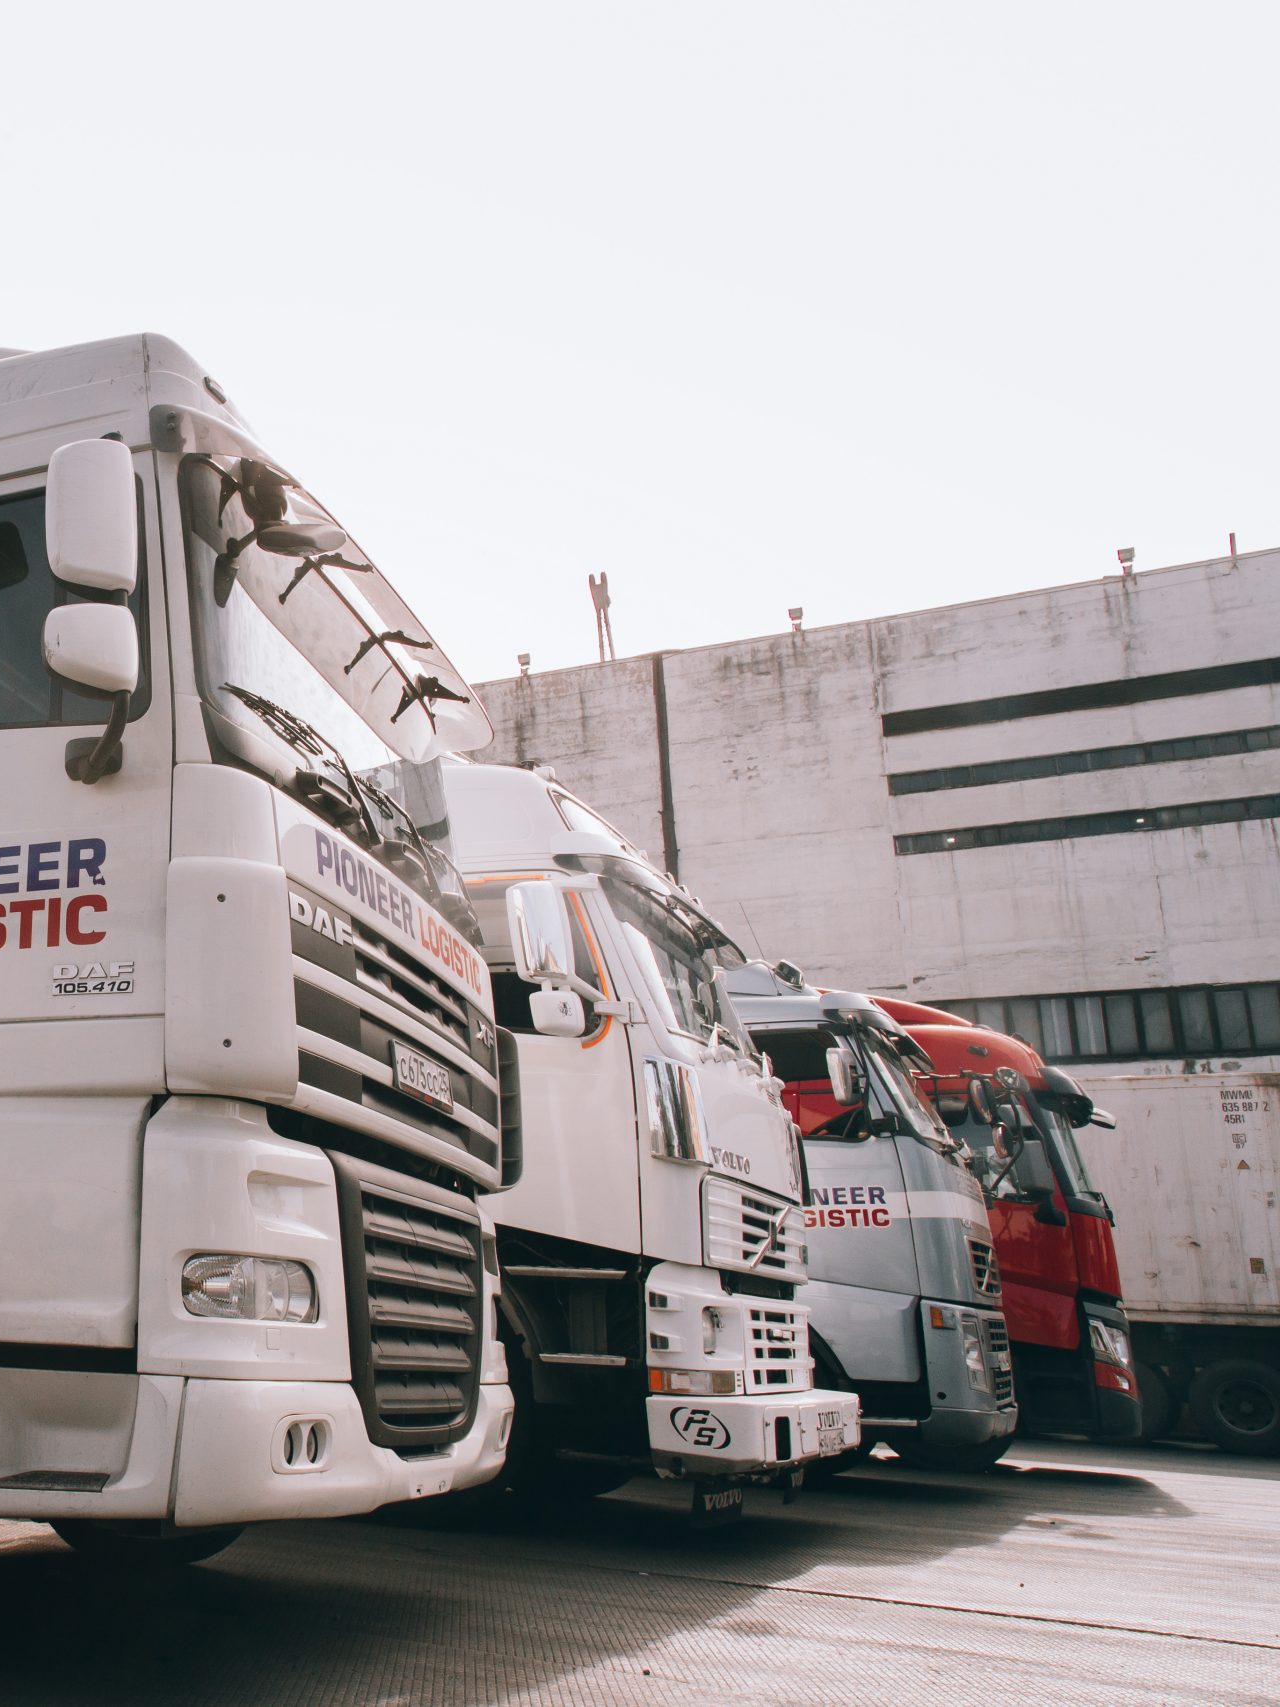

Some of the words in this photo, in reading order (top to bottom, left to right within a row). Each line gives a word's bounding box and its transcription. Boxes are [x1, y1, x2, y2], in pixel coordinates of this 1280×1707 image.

[288, 891, 354, 947] DAF
[314, 828, 416, 940] PIONEER
[417, 905, 482, 994] LOGISTIC
[53, 960, 135, 981] DAF
[54, 980, 132, 994] 105.410
[710, 1146, 751, 1175] VOLVO
[810, 1186, 887, 1206] NEER
[803, 1208, 890, 1228] GISTIC
[704, 1487, 742, 1511] VOLVO
